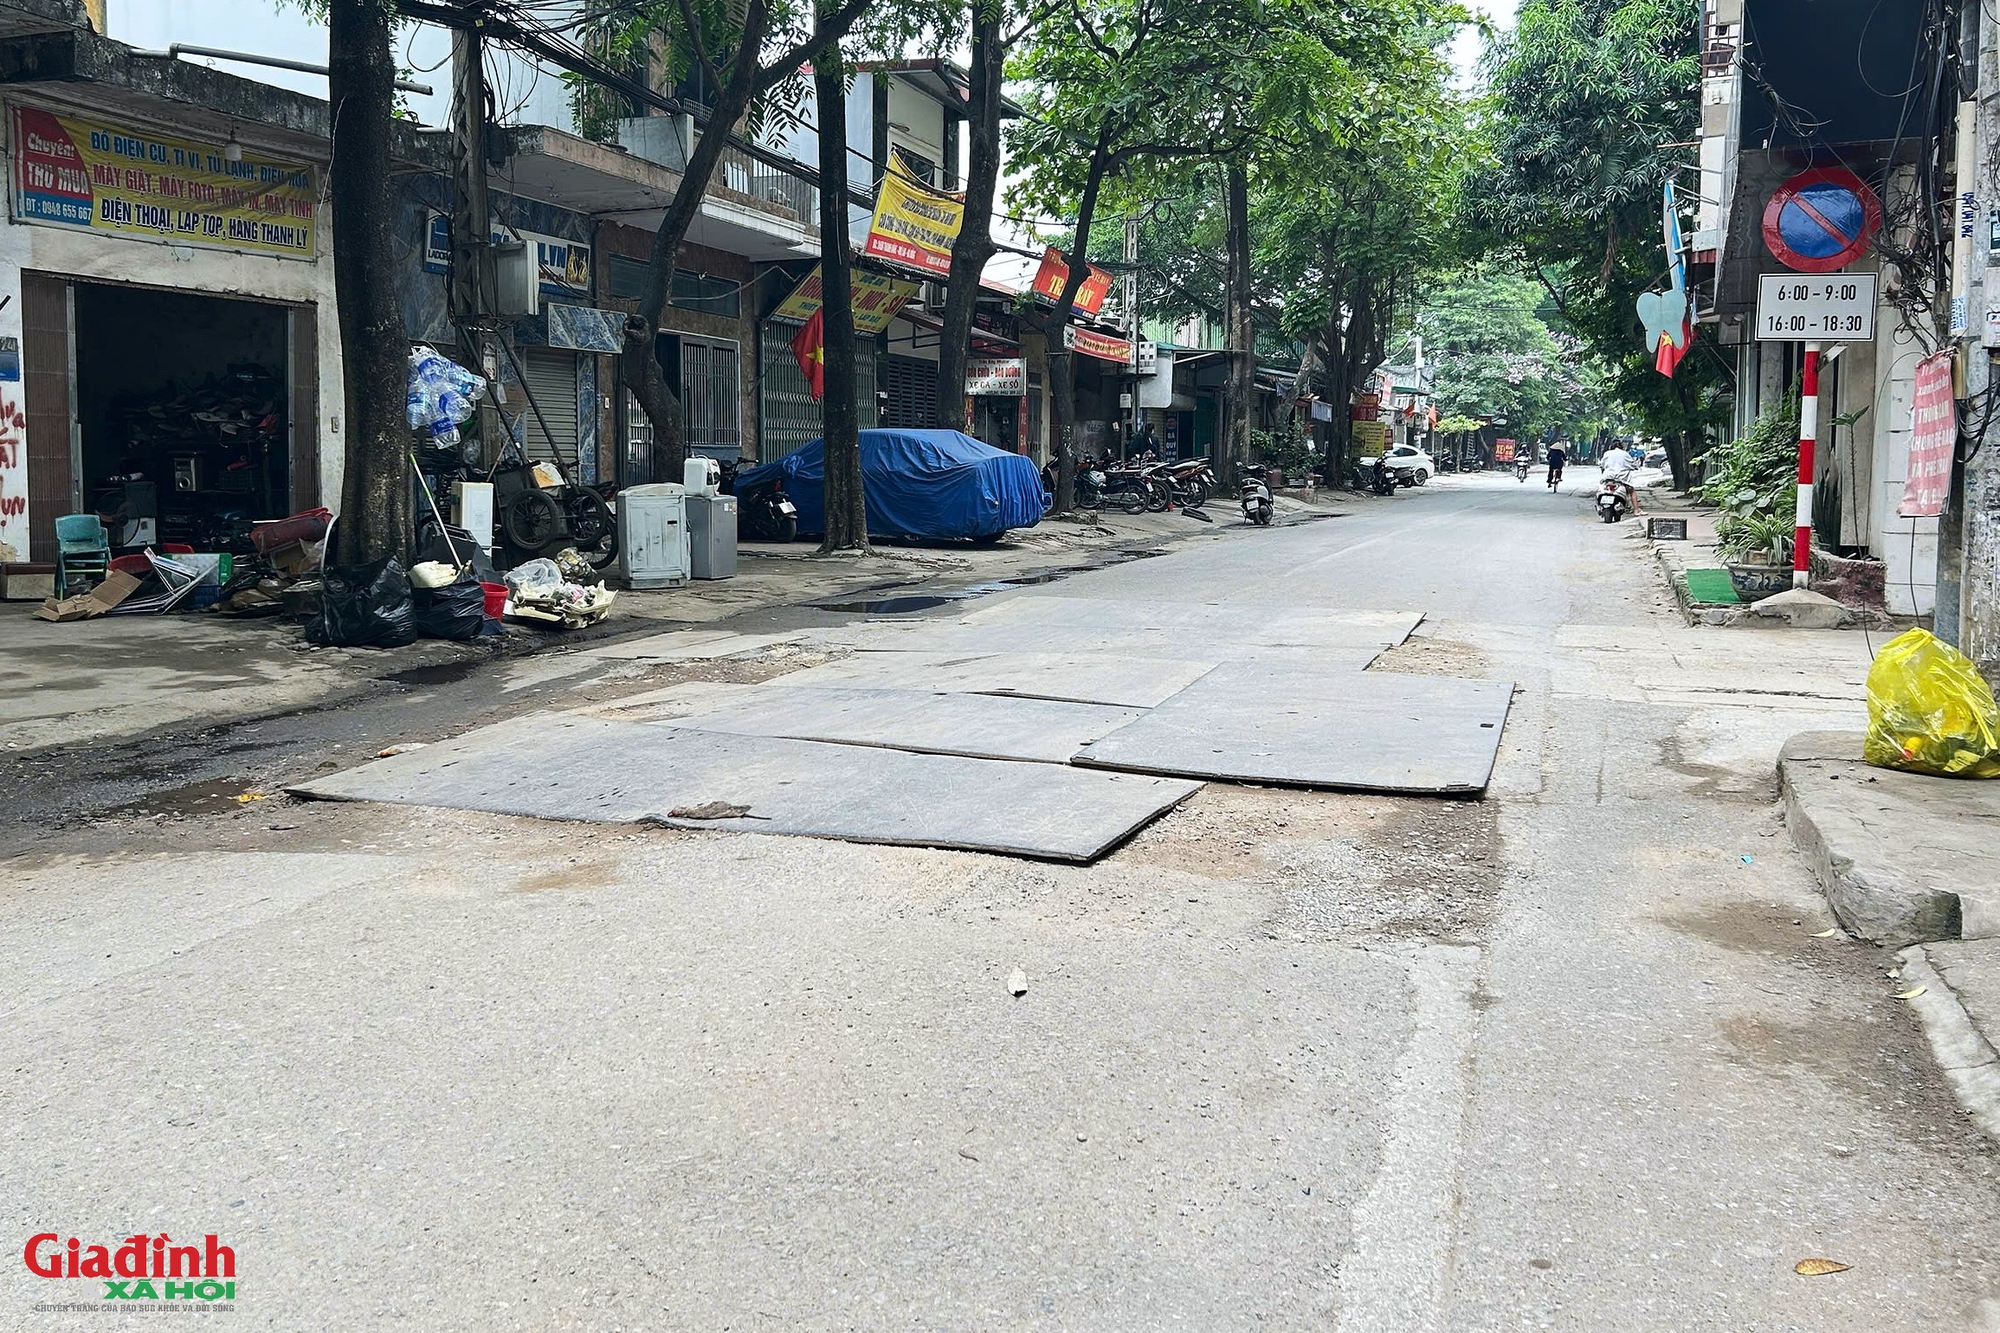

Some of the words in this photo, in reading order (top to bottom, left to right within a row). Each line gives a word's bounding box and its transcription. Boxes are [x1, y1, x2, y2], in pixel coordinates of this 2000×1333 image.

[114, 135, 145, 161] ĐIỆN
[173, 148, 184, 166] TI
[57, 167, 89, 195] MUA
[93, 162, 121, 187] MÁY
[159, 174, 184, 198] MÁY
[62, 203, 77, 218] 655
[78, 206, 92, 220] 667
[101, 197, 132, 228] ĐIỆN
[134, 203, 174, 233] THOẠI,
[177, 210, 200, 233] LAP
[202, 214, 226, 240] TOP,
[229, 216, 259, 242] HÀNG
[260, 223, 294, 248] THANH
[296, 226, 309, 249] LÝ
[1778, 285, 1808, 300] 6:00
[1825, 285, 1856, 300] 9:00
[1768, 315, 1805, 331] 16:00
[1822, 315, 1862, 331] 18:30
